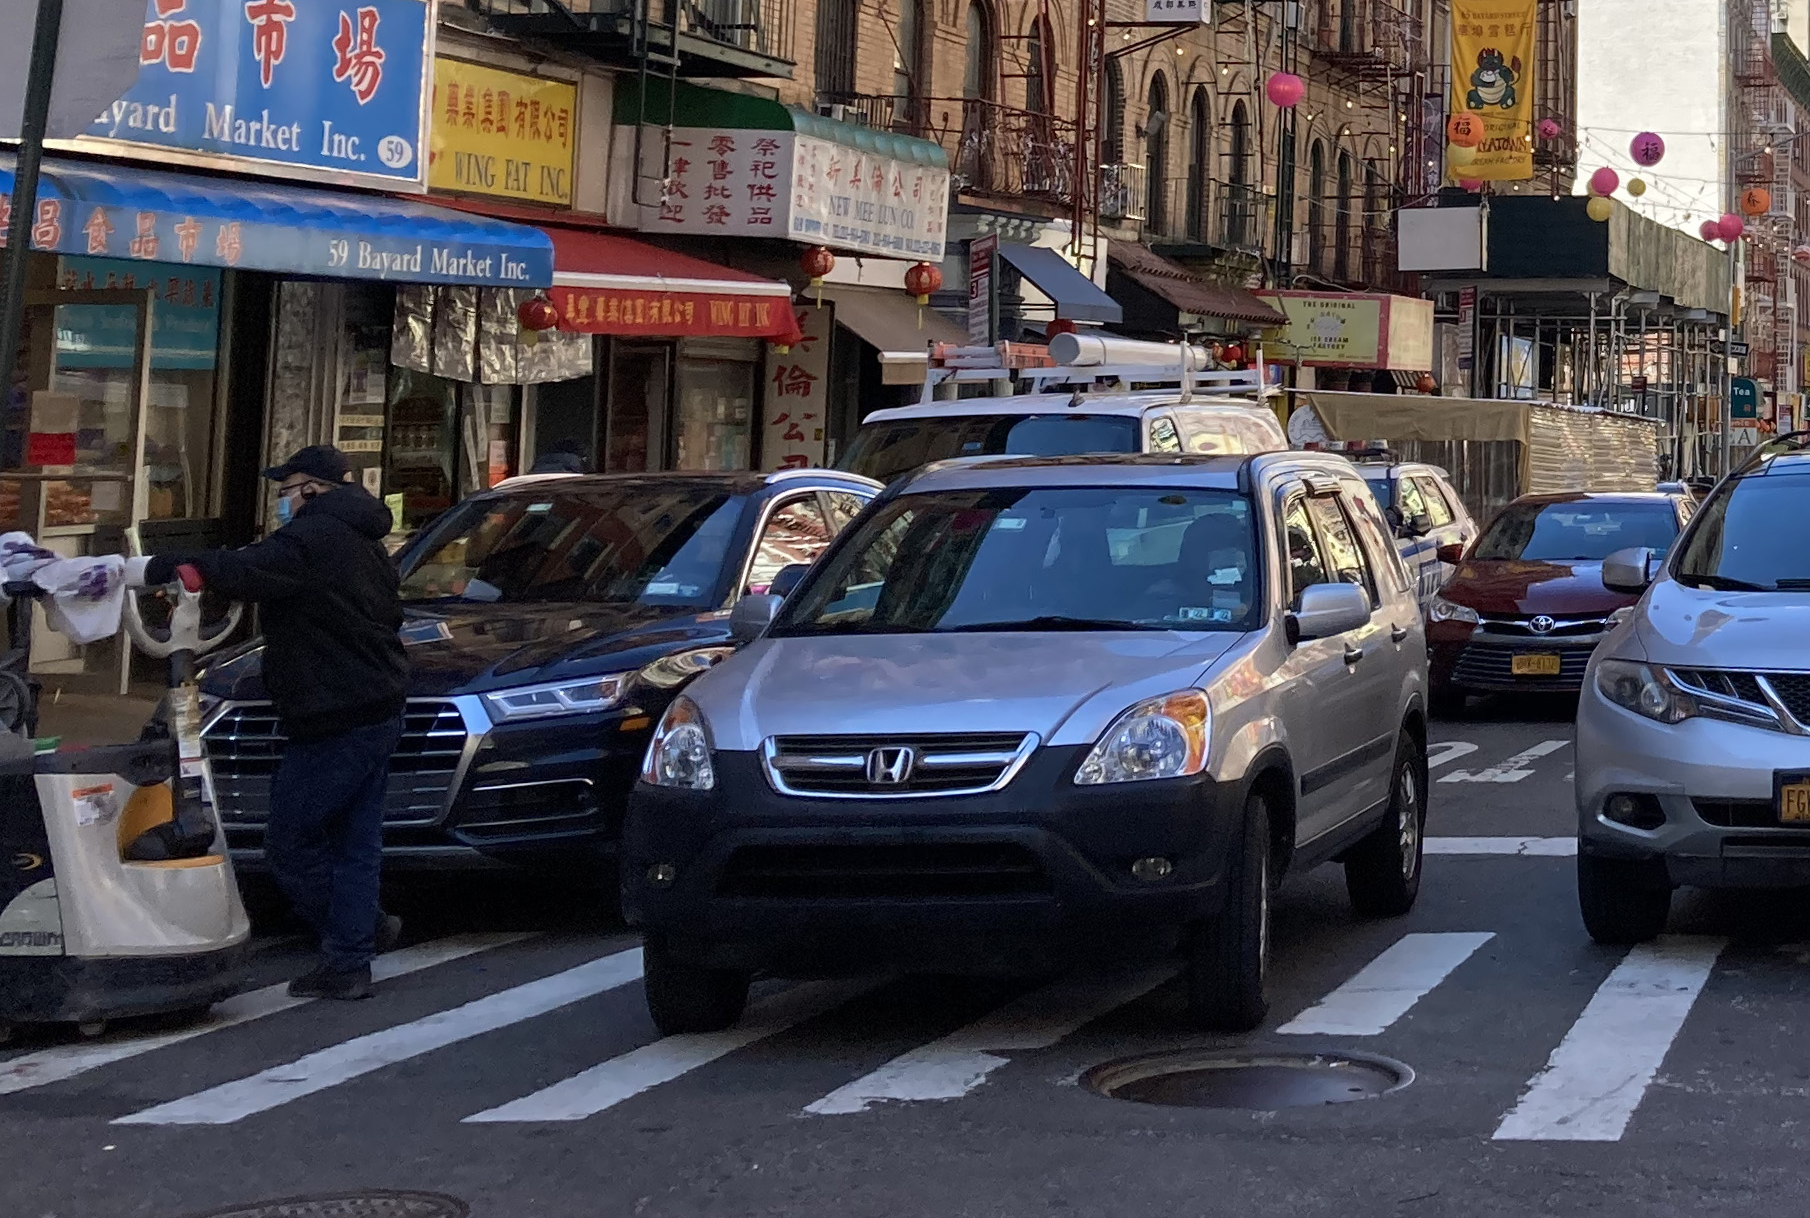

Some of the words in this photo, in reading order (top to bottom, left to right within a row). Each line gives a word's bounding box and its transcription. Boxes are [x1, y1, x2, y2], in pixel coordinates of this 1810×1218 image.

[94, 93, 177, 138] yard
[203, 103, 302, 153] Market
[321, 119, 366, 162] Inc.
[383, 141, 405, 162] 59
[454, 151, 497, 189] WING
[503, 158, 531, 193] FAT
[829, 194, 851, 217] NEW
[854, 200, 875, 224] MEE
[328, 238, 350, 267] 59
[357, 242, 422, 280] Bayard
[430, 248, 492, 279] Market
[499, 253, 530, 281] Inc.
[1733, 386, 1751, 396] Tea
